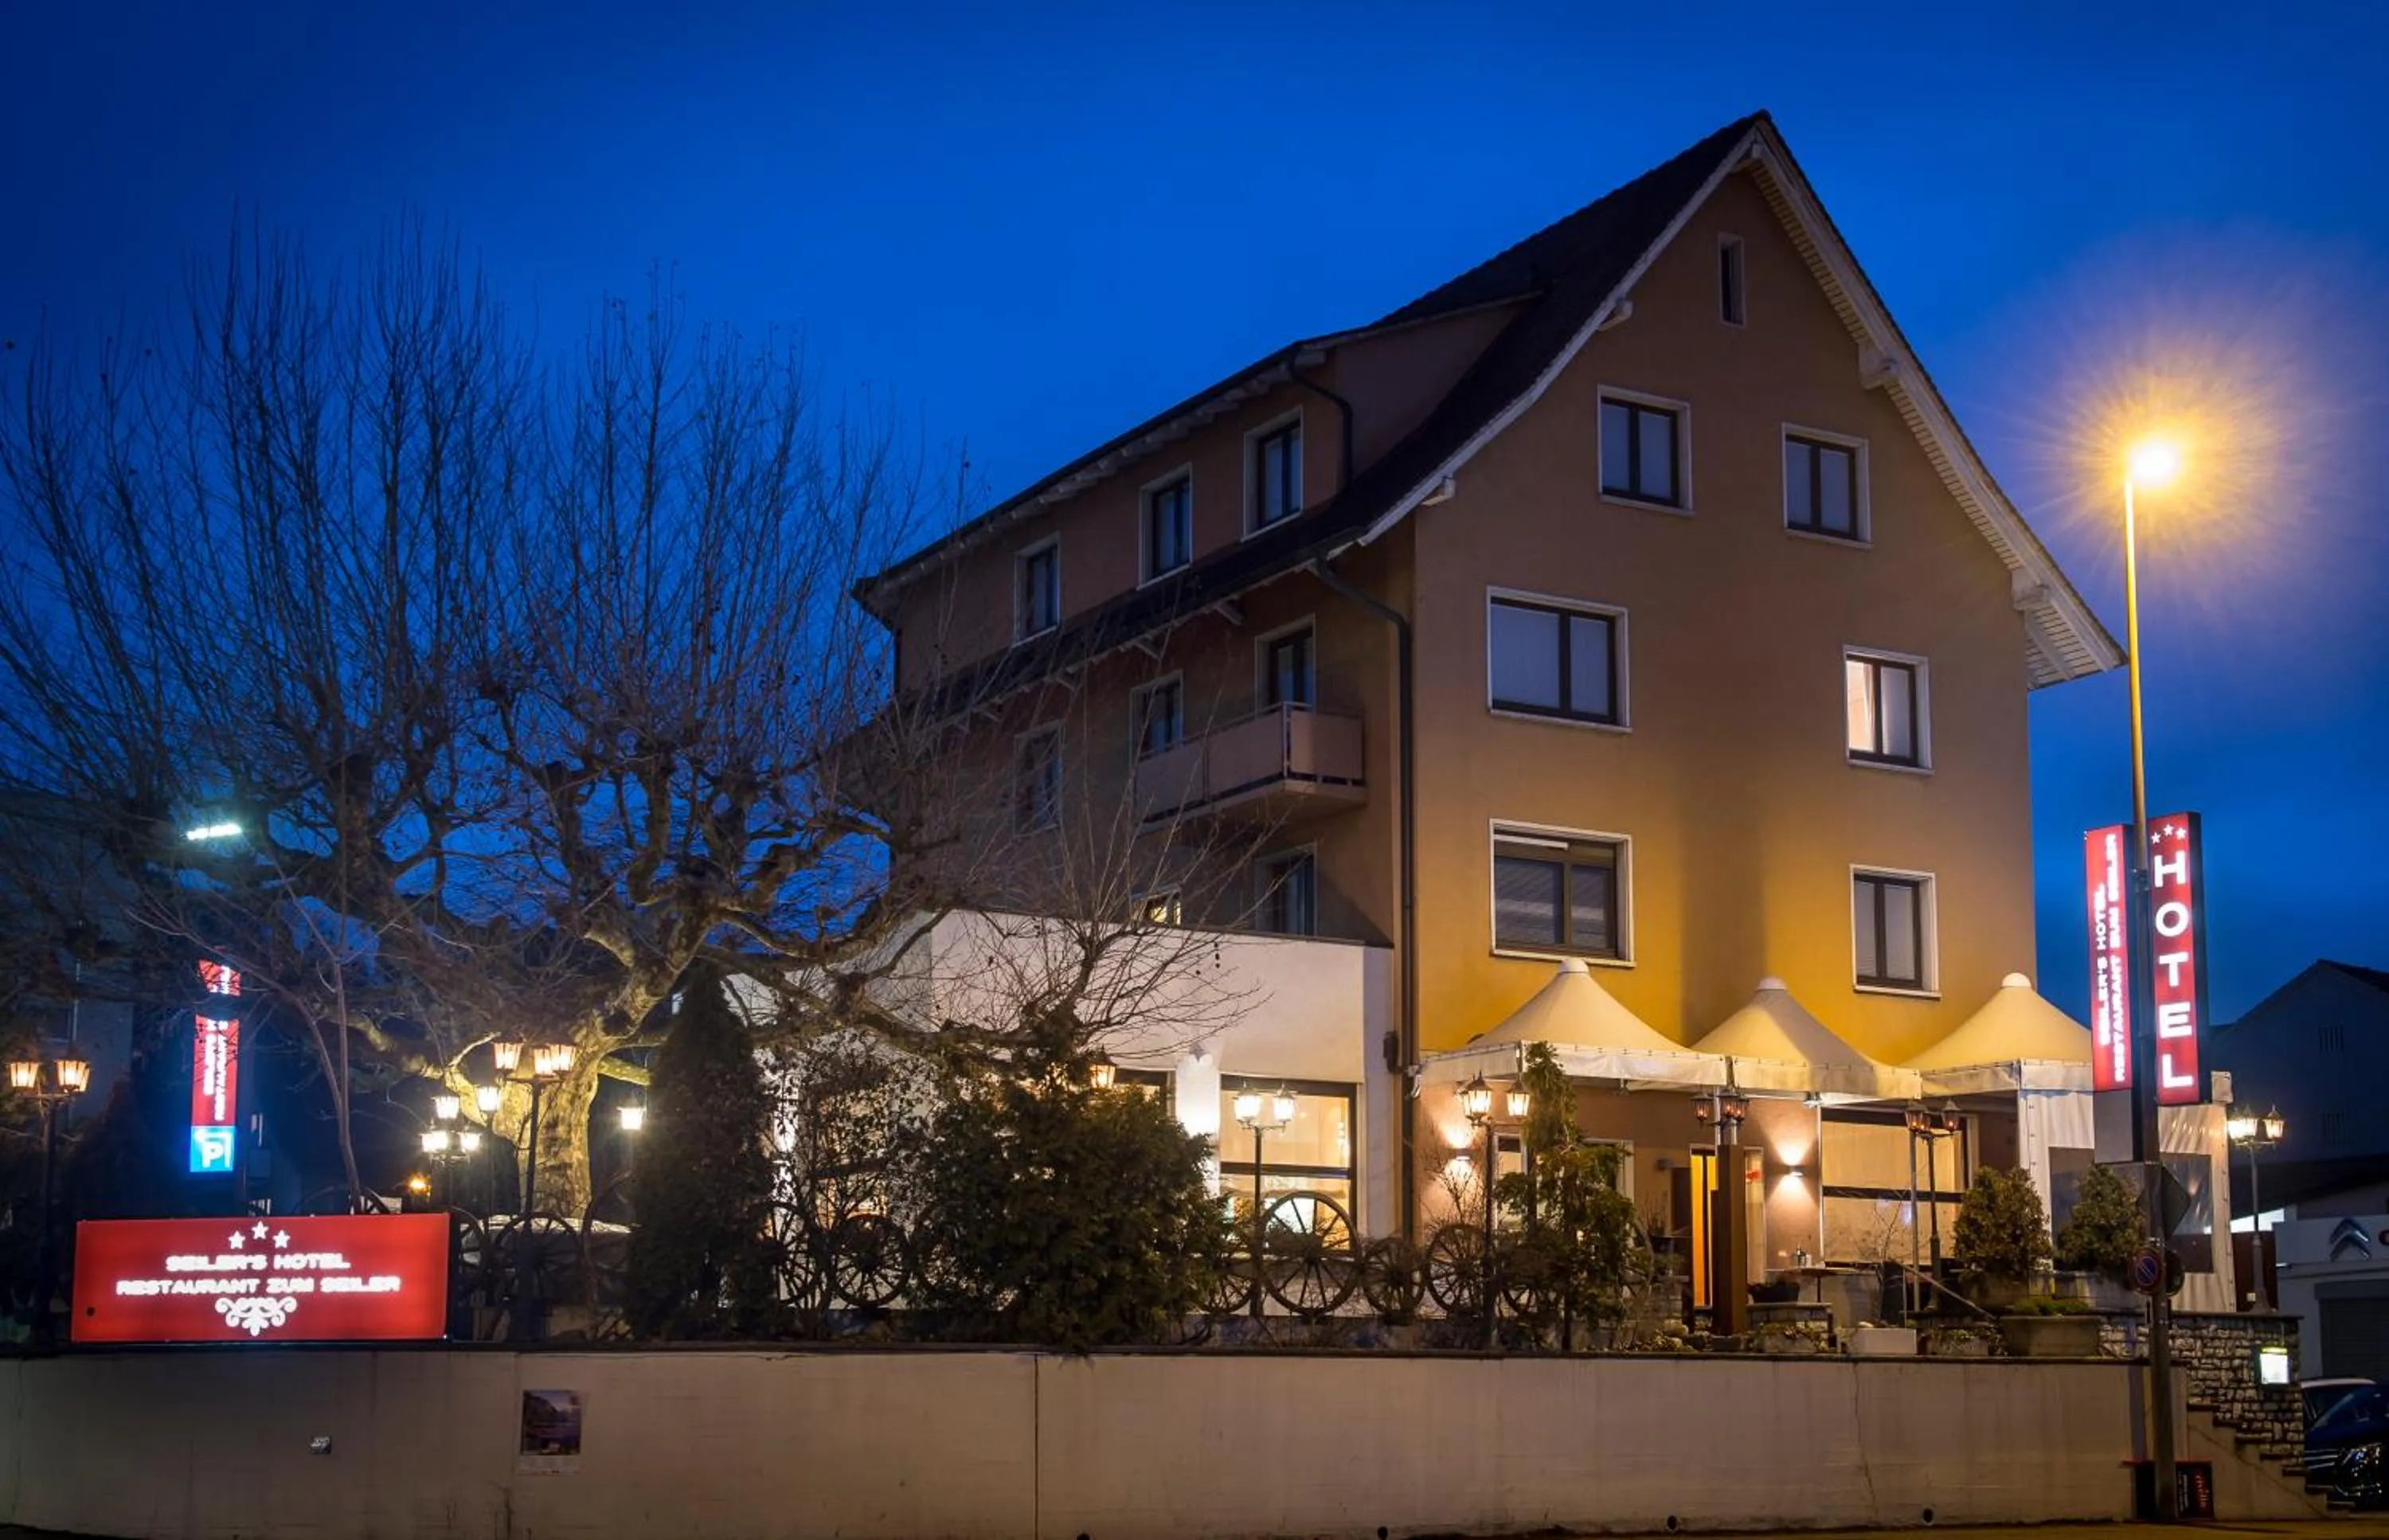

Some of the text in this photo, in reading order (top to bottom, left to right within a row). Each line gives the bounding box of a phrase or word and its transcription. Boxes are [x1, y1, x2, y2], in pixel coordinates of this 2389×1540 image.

[2153, 850, 2193, 1089] HOTEL
[202, 1142, 224, 1168] P
[274, 1253, 350, 1269] HOTEL
[116, 1278, 260, 1296] RESTAURANT
